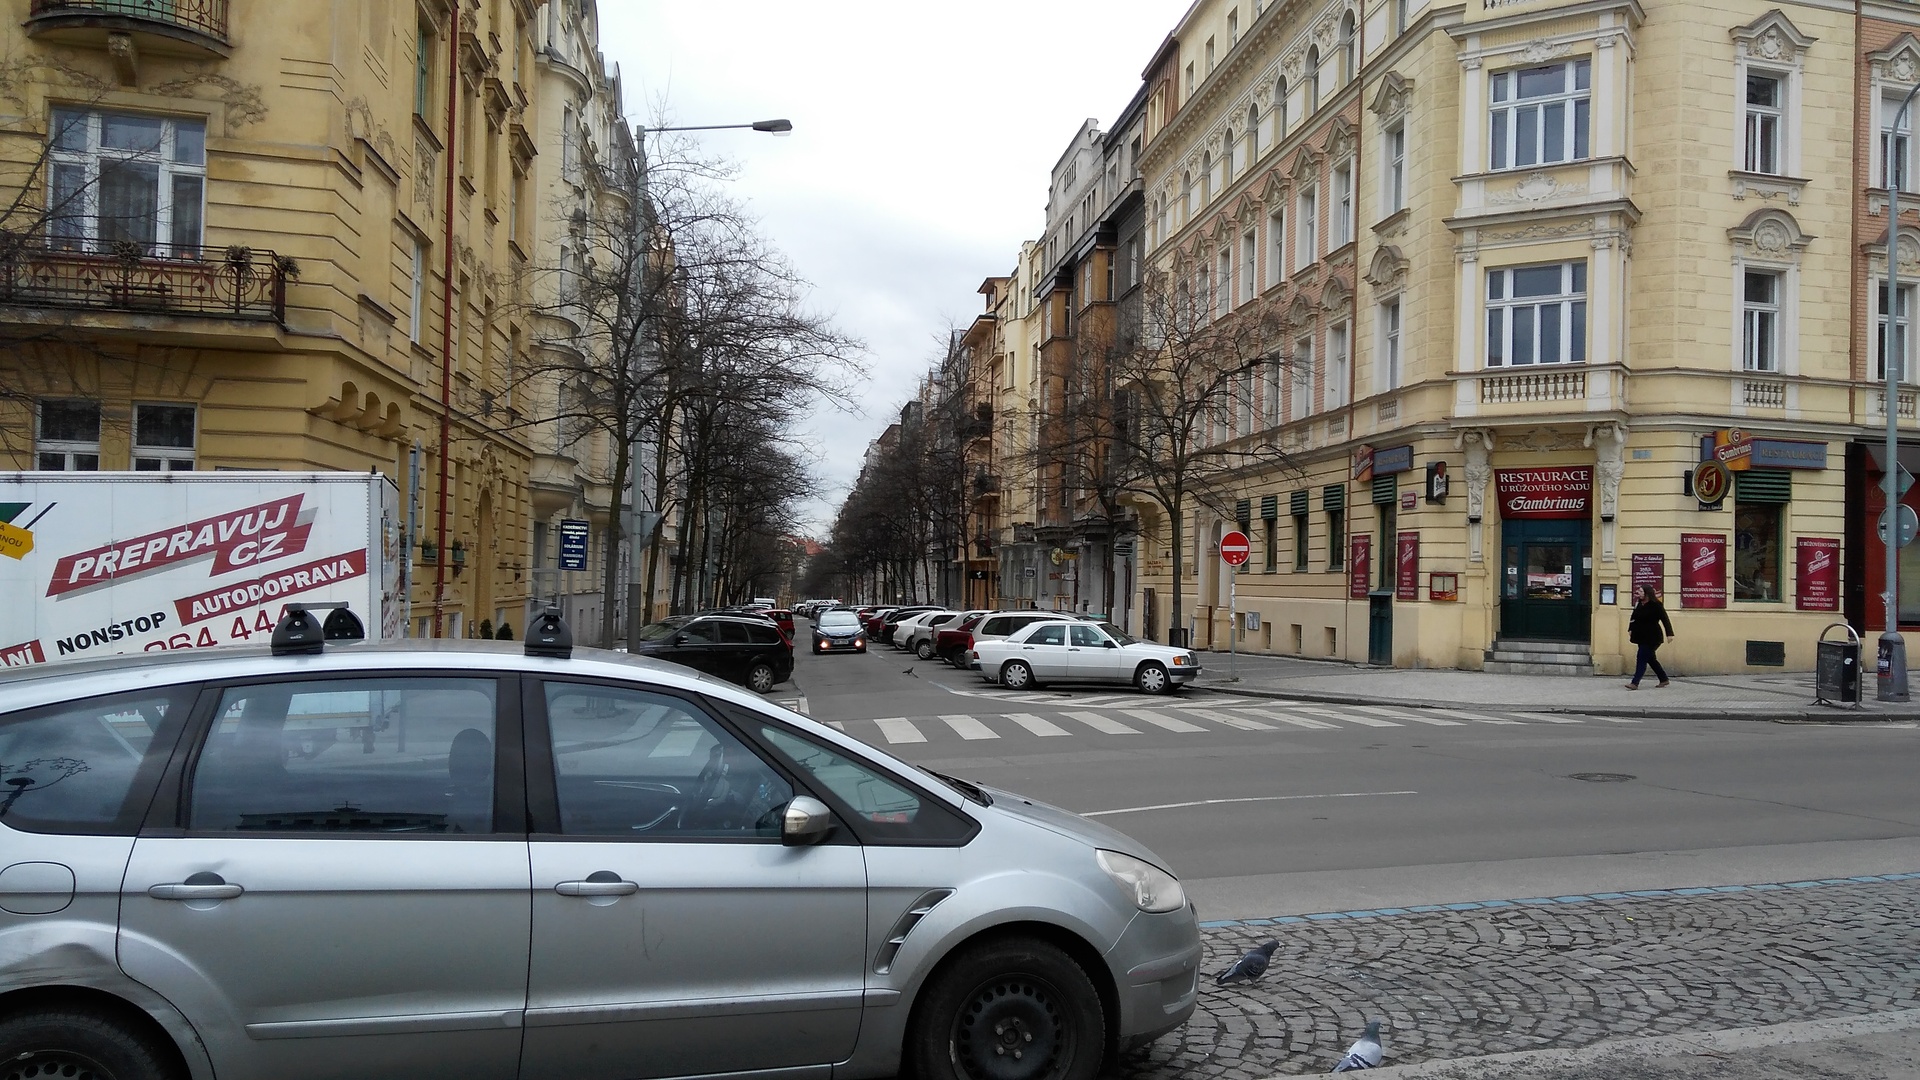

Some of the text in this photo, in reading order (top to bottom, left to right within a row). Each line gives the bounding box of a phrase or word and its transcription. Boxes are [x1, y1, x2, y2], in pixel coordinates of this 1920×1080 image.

[1719, 443, 1752, 461] Gambrinus
[1762, 447, 1824, 461] RESTAURACE
[1500, 470, 1589, 483] RESTAURACE
[1509, 483, 1562, 492] RŮŽOVÉHO
[1563, 483, 1590, 491] SADU
[1507, 496, 1586, 511] Gambrinus
[68, 502, 290, 585] PREPRAVUJ
[228, 531, 289, 567] CZ
[191, 558, 355, 618] AUTODOPRAVA
[56, 611, 166, 656] NONSTOP
